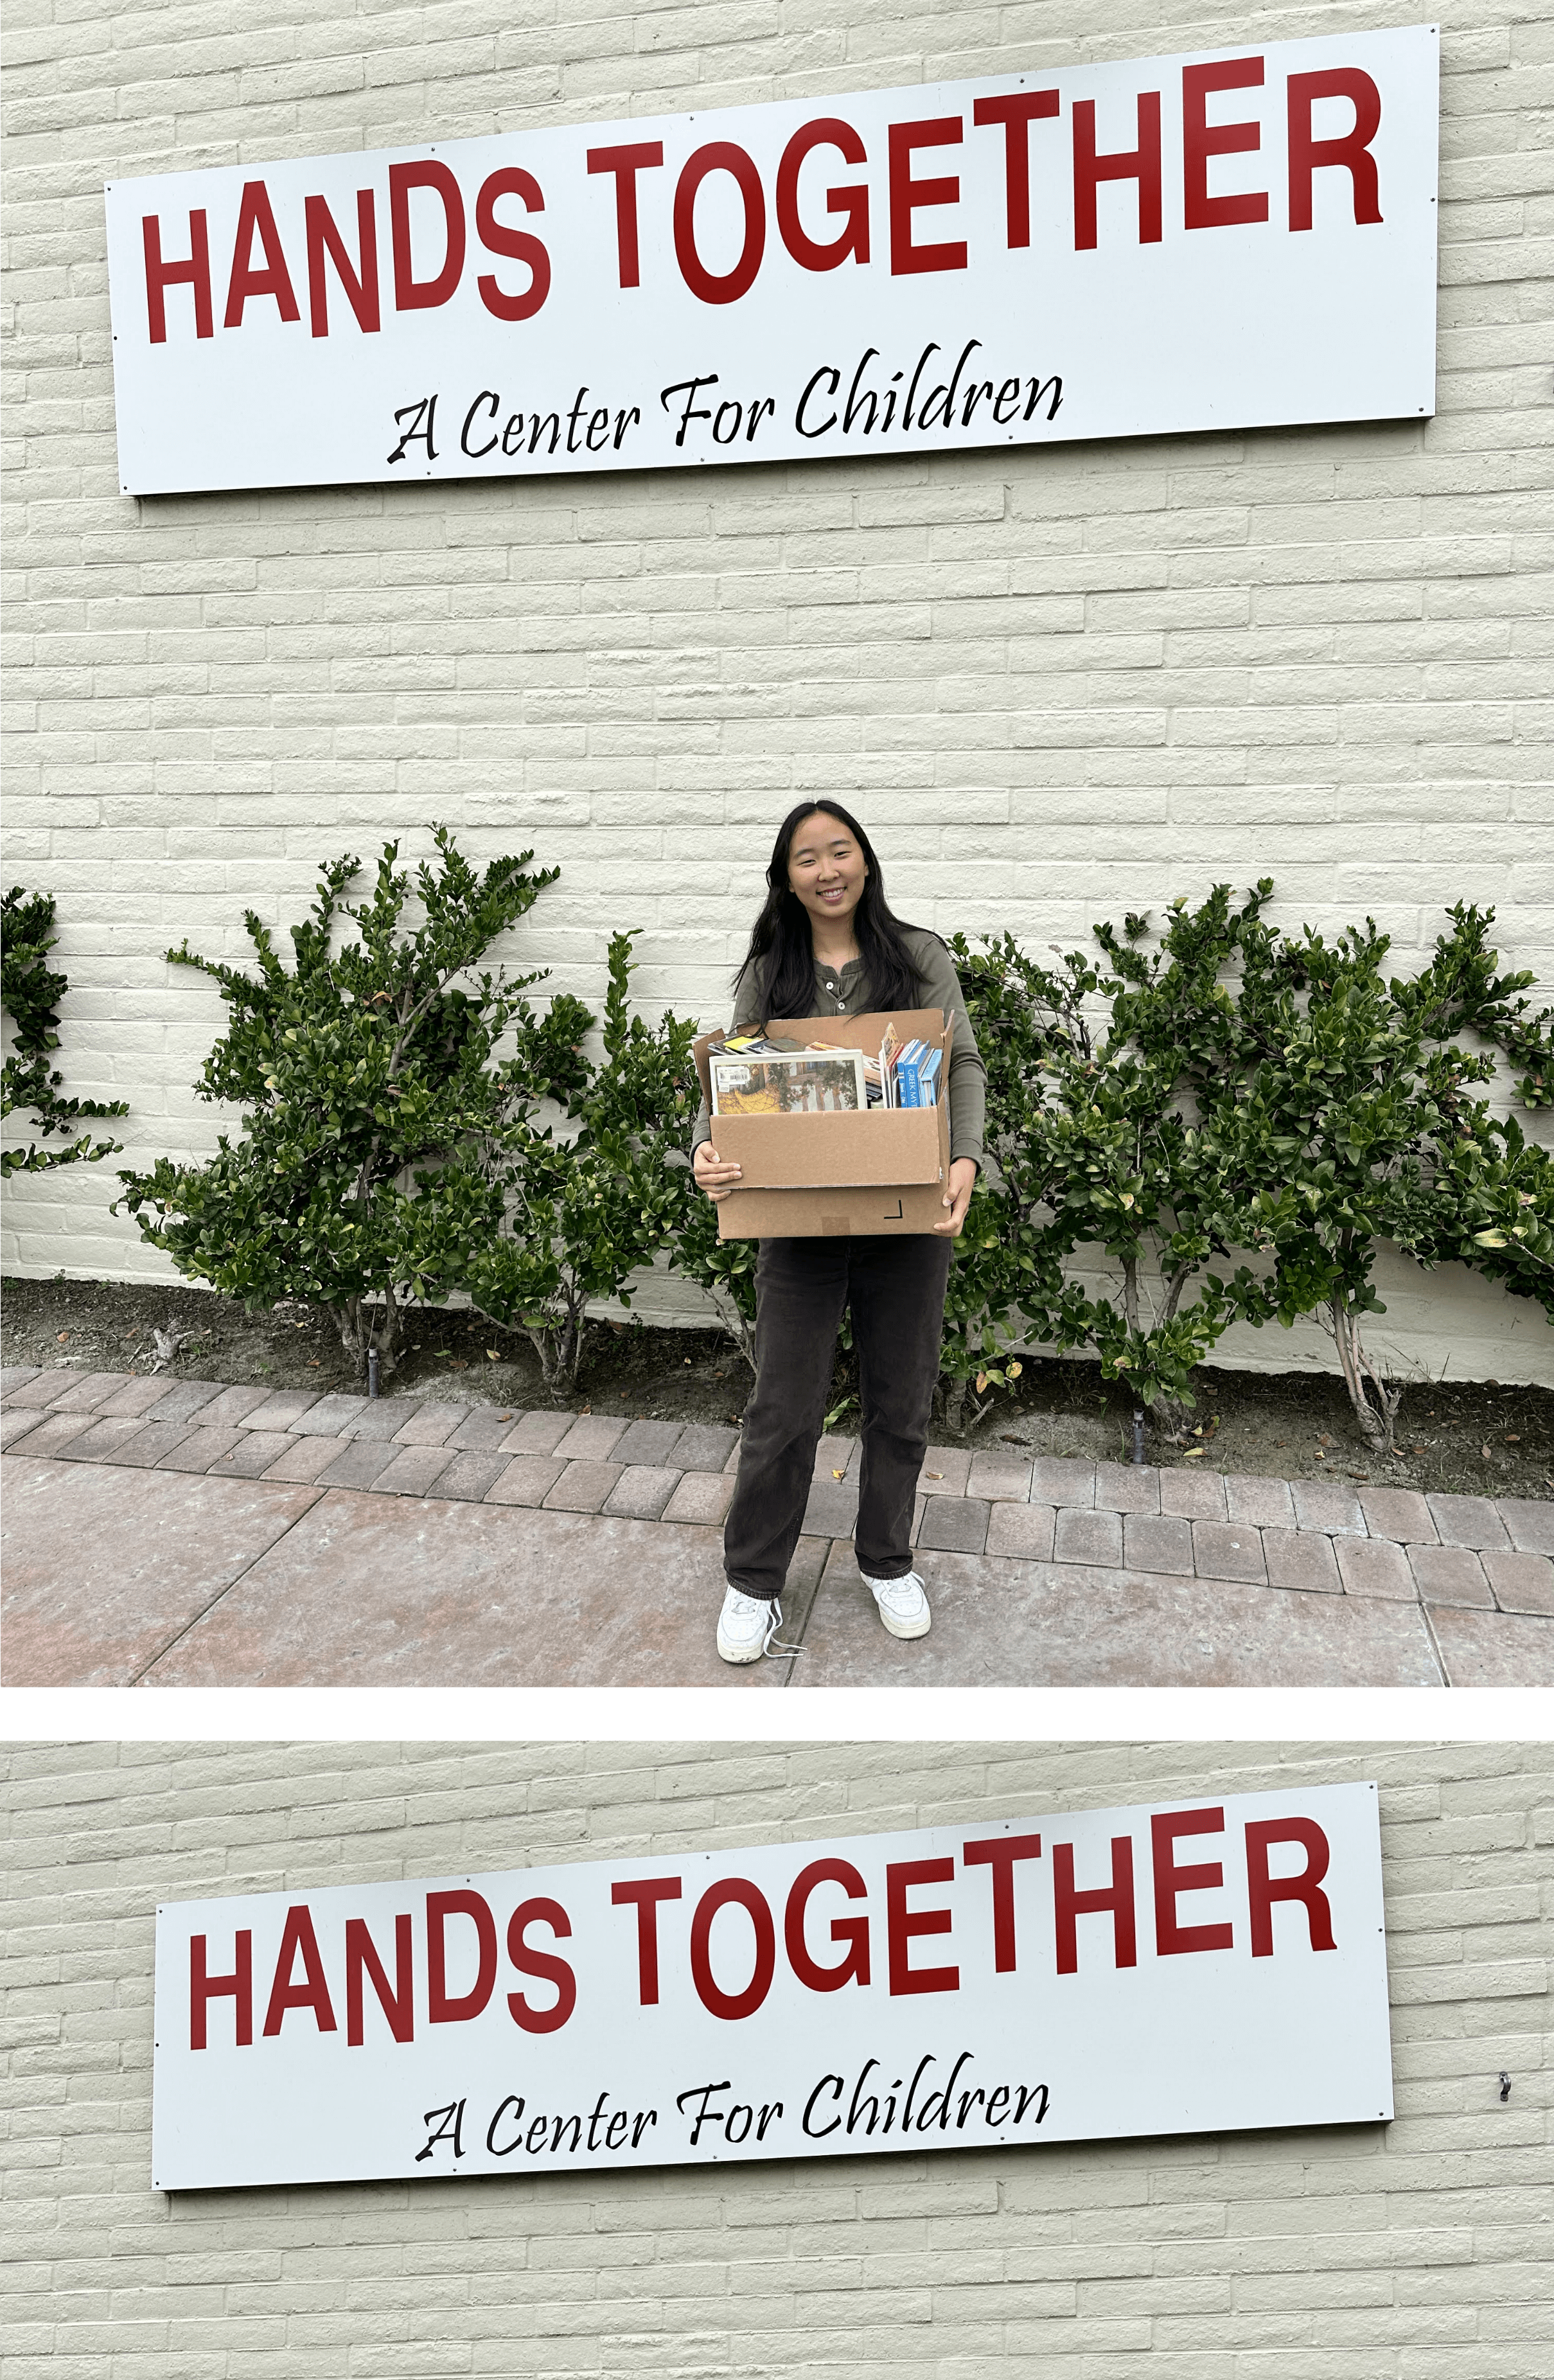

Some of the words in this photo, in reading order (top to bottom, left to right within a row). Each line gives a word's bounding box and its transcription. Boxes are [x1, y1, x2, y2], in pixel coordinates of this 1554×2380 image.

[143, 161, 550, 343] HANDS
[587, 57, 1383, 304] TOGETHER
[387, 395, 439, 464] A
[461, 387, 640, 457] Center
[661, 375, 774, 447] For
[796, 339, 1063, 438] Children
[907, 1069, 916, 1090] GREEK
[191, 1890, 576, 2050] HANDS
[612, 1807, 1336, 2020] TOGETHER
[415, 2099, 466, 2162] A
[487, 2092, 657, 2156] Center
[676, 2081, 783, 2145] For
[803, 2052, 1050, 2138] Children
